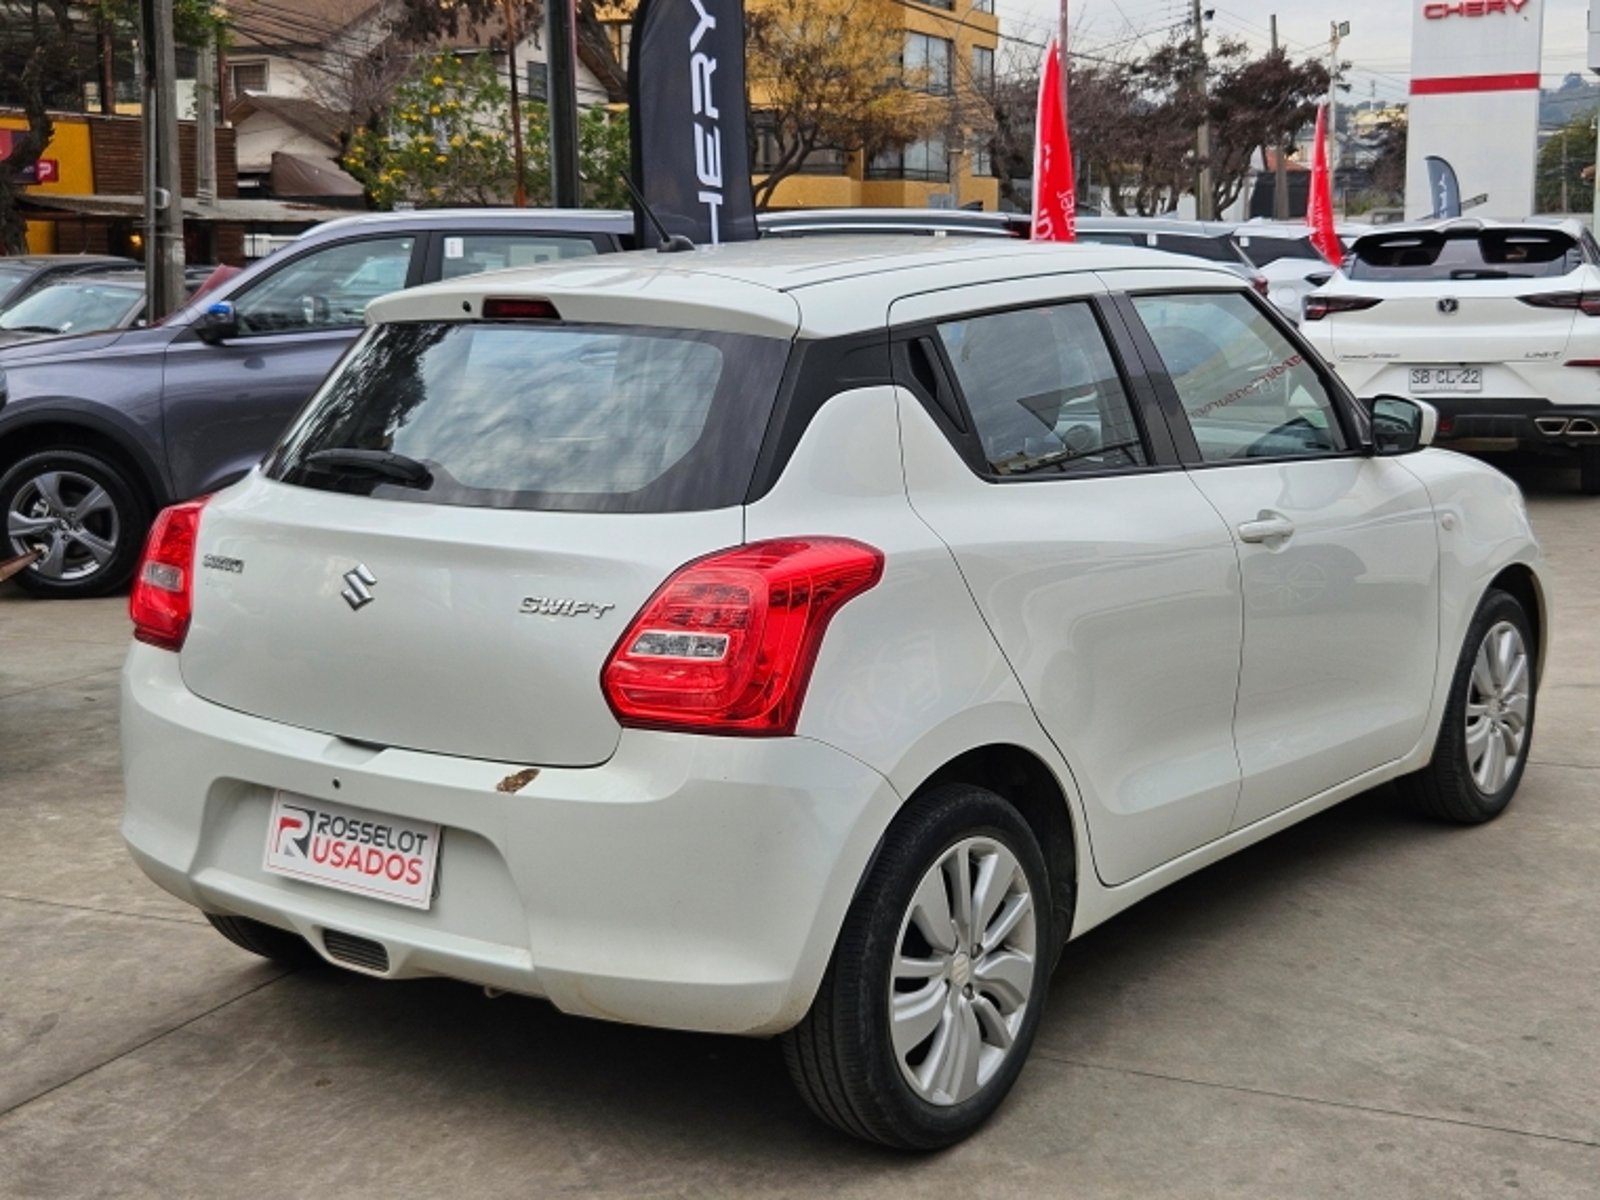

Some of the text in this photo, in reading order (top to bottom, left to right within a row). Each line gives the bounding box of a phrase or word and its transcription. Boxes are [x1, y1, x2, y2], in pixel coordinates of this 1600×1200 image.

[1424, 0, 1528, 19] CHERY
[690, 0, 723, 245] HERY
[519, 597, 615, 619] SWIFT
[317, 813, 428, 855] ROSSELOT
[312, 837, 424, 885] USADOS
